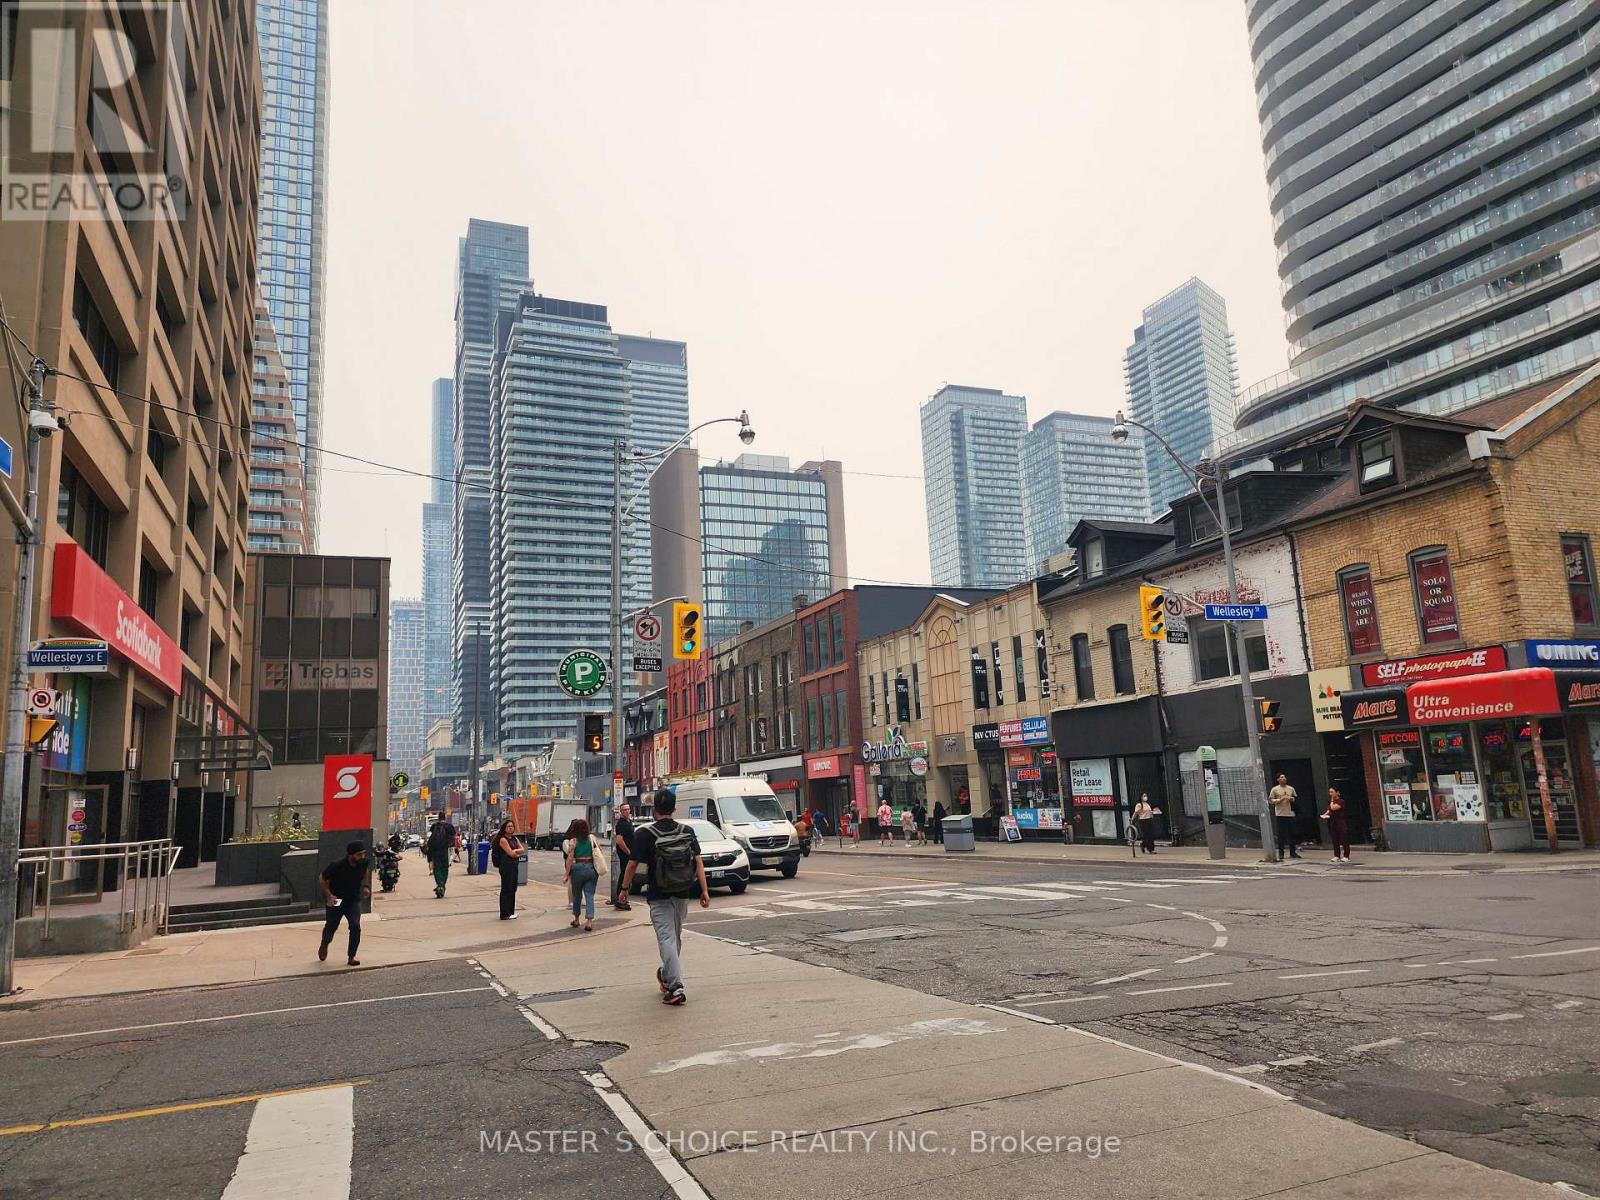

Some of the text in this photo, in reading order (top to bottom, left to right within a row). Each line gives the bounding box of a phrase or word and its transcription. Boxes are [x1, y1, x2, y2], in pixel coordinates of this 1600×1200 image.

[1423, 576, 1446, 586] SOLO
[1429, 587, 1442, 595] OR
[1350, 598, 1373, 608] WHEN
[1424, 595, 1453, 607] SQUAD
[1212, 605, 1254, 619] Wellesley
[1355, 607, 1370, 617] YOU
[116, 600, 161, 671] Scotiabank
[31, 651, 103, 664] Wellesley St E
[561, 652, 603, 671] MUNICIPAL
[299, 663, 375, 679] Trebas
[562, 675, 605, 695] PARKING
[1413, 695, 1450, 708] Ultra
[1353, 699, 1397, 720] Mars
[1415, 702, 1514, 720] Convenience
[1022, 720, 1047, 730] CELLULAR
[1379, 732, 1419, 743] BITCOIN
[862, 741, 903, 763] Galleria
[1072, 767, 1090, 777] Retail
[1072, 778, 1102, 787] For Lease
